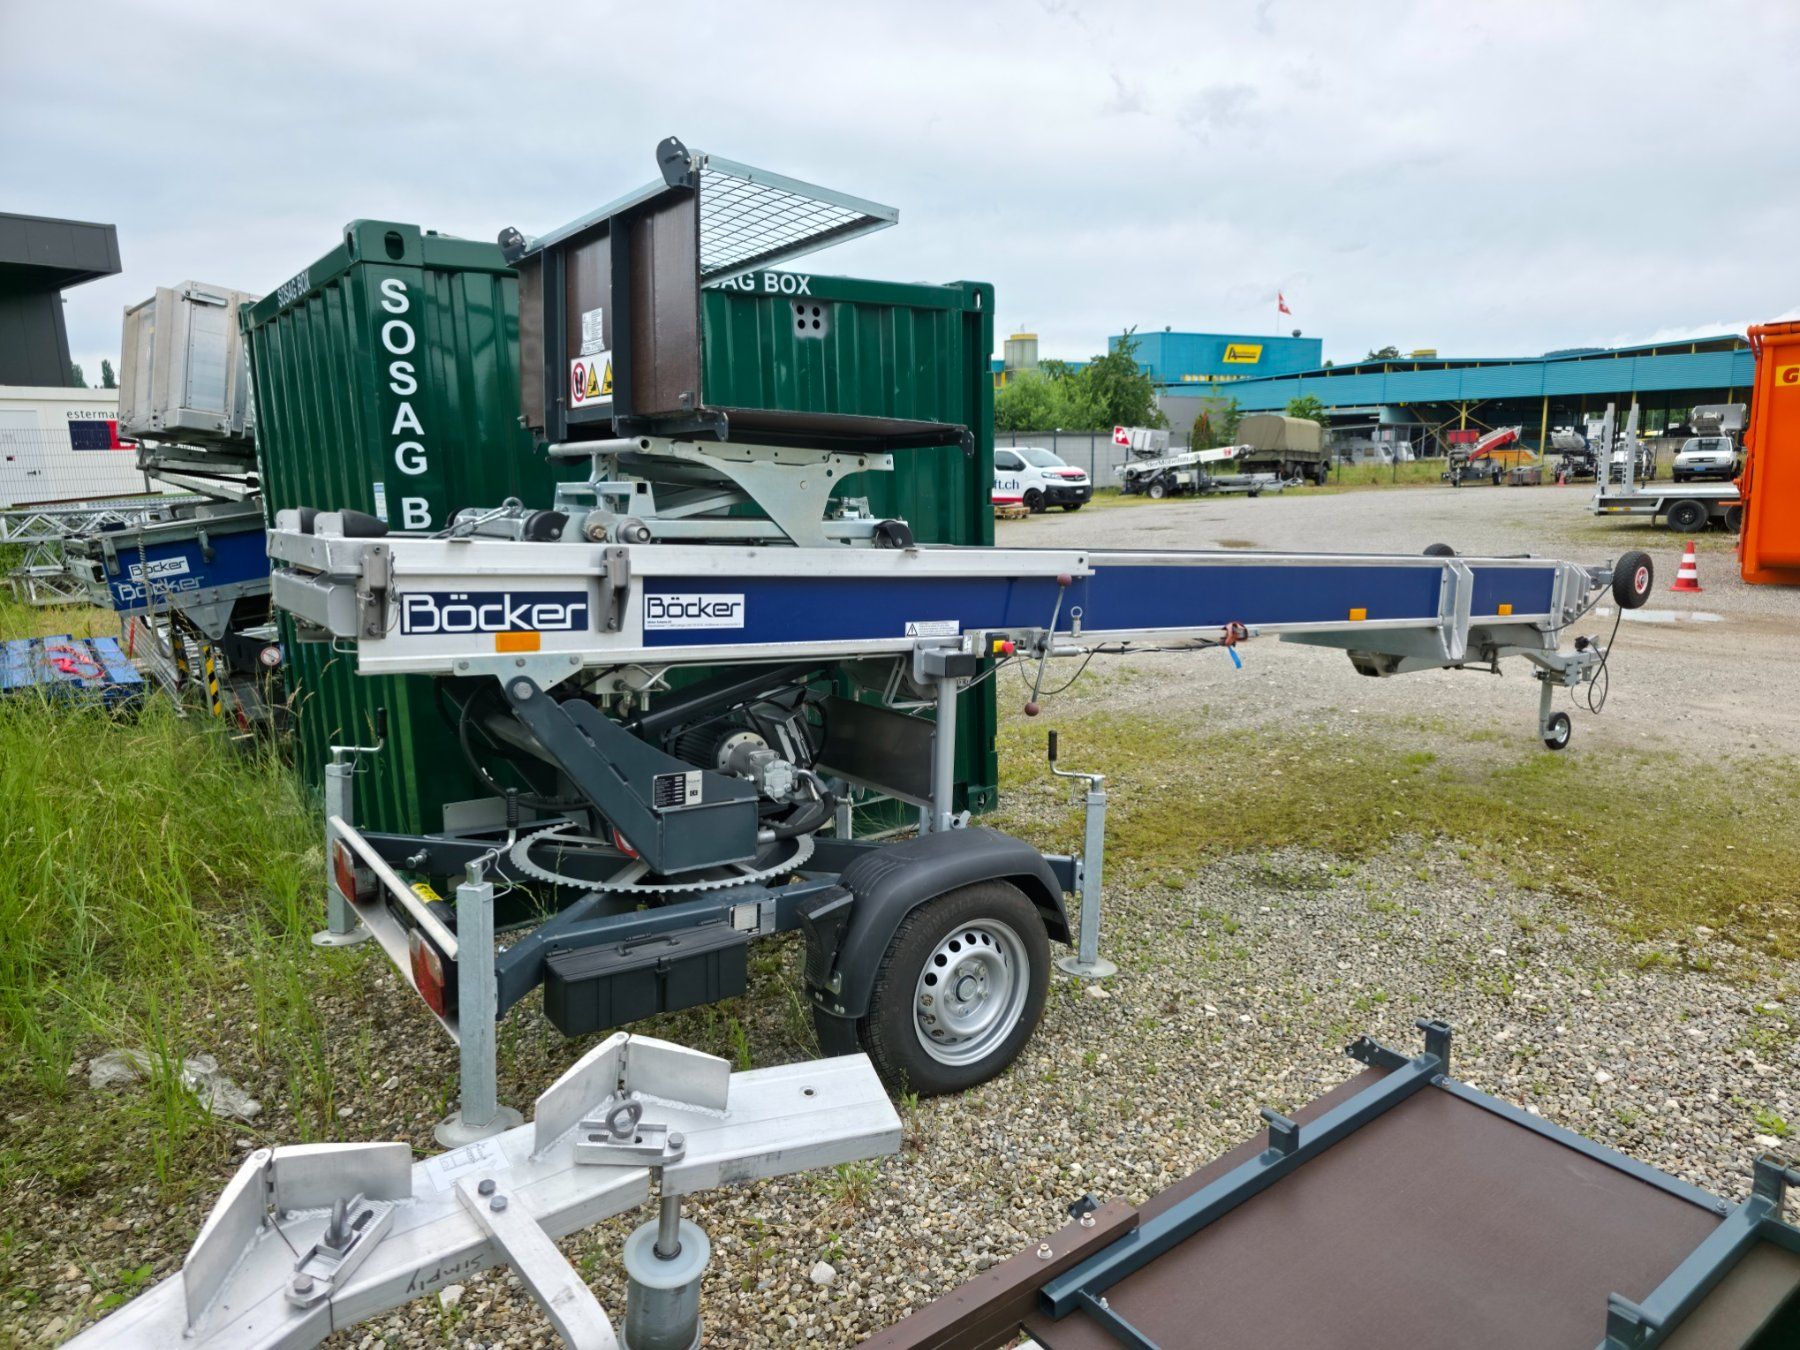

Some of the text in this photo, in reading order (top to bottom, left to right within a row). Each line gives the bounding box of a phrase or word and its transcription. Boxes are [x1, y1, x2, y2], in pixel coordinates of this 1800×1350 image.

[710, 273, 812, 296] AG BOX
[380, 278, 428, 475] SOSAG
[403, 594, 587, 633] Böcker
[647, 597, 741, 618] Böcker
